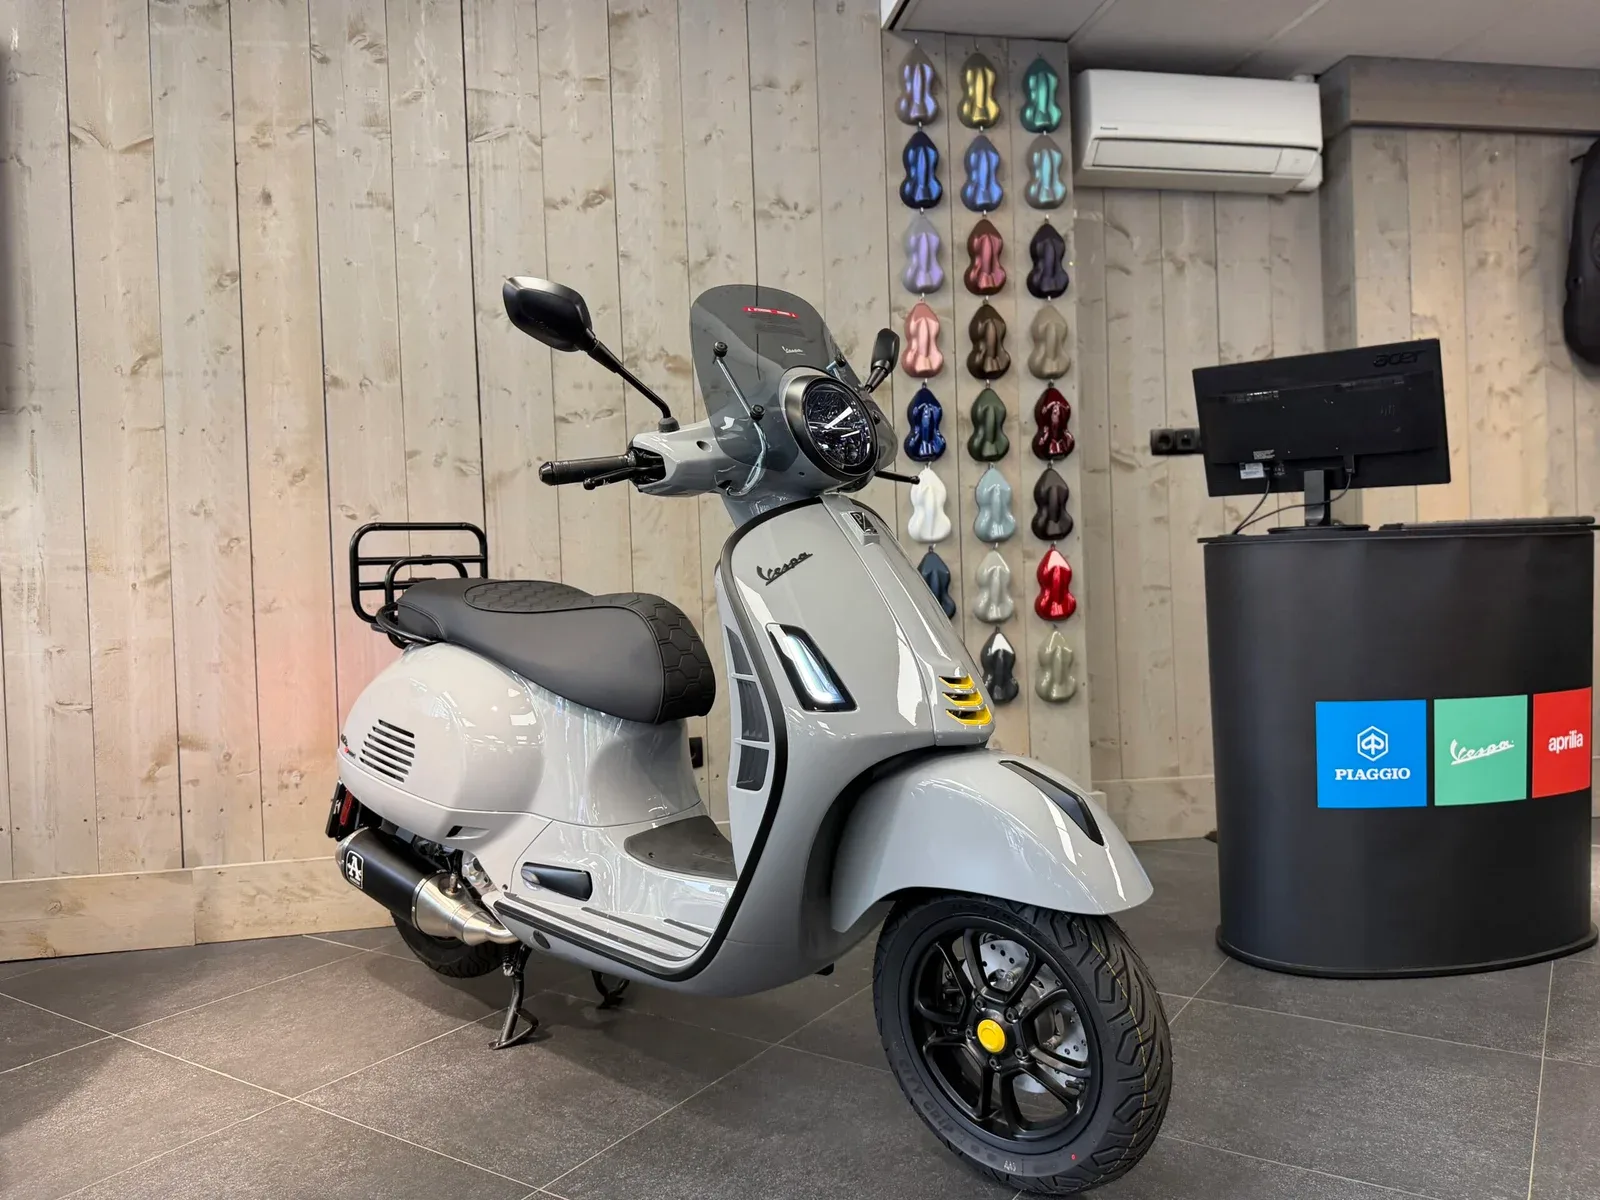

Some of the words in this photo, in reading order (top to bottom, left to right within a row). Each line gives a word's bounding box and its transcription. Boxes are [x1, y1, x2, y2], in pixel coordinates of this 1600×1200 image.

[756, 552, 814, 586] Vespa
[1450, 738, 1515, 766] Vespa
[1548, 729, 1584, 754] aprilia
[1335, 767, 1411, 781] PIAGGIO
